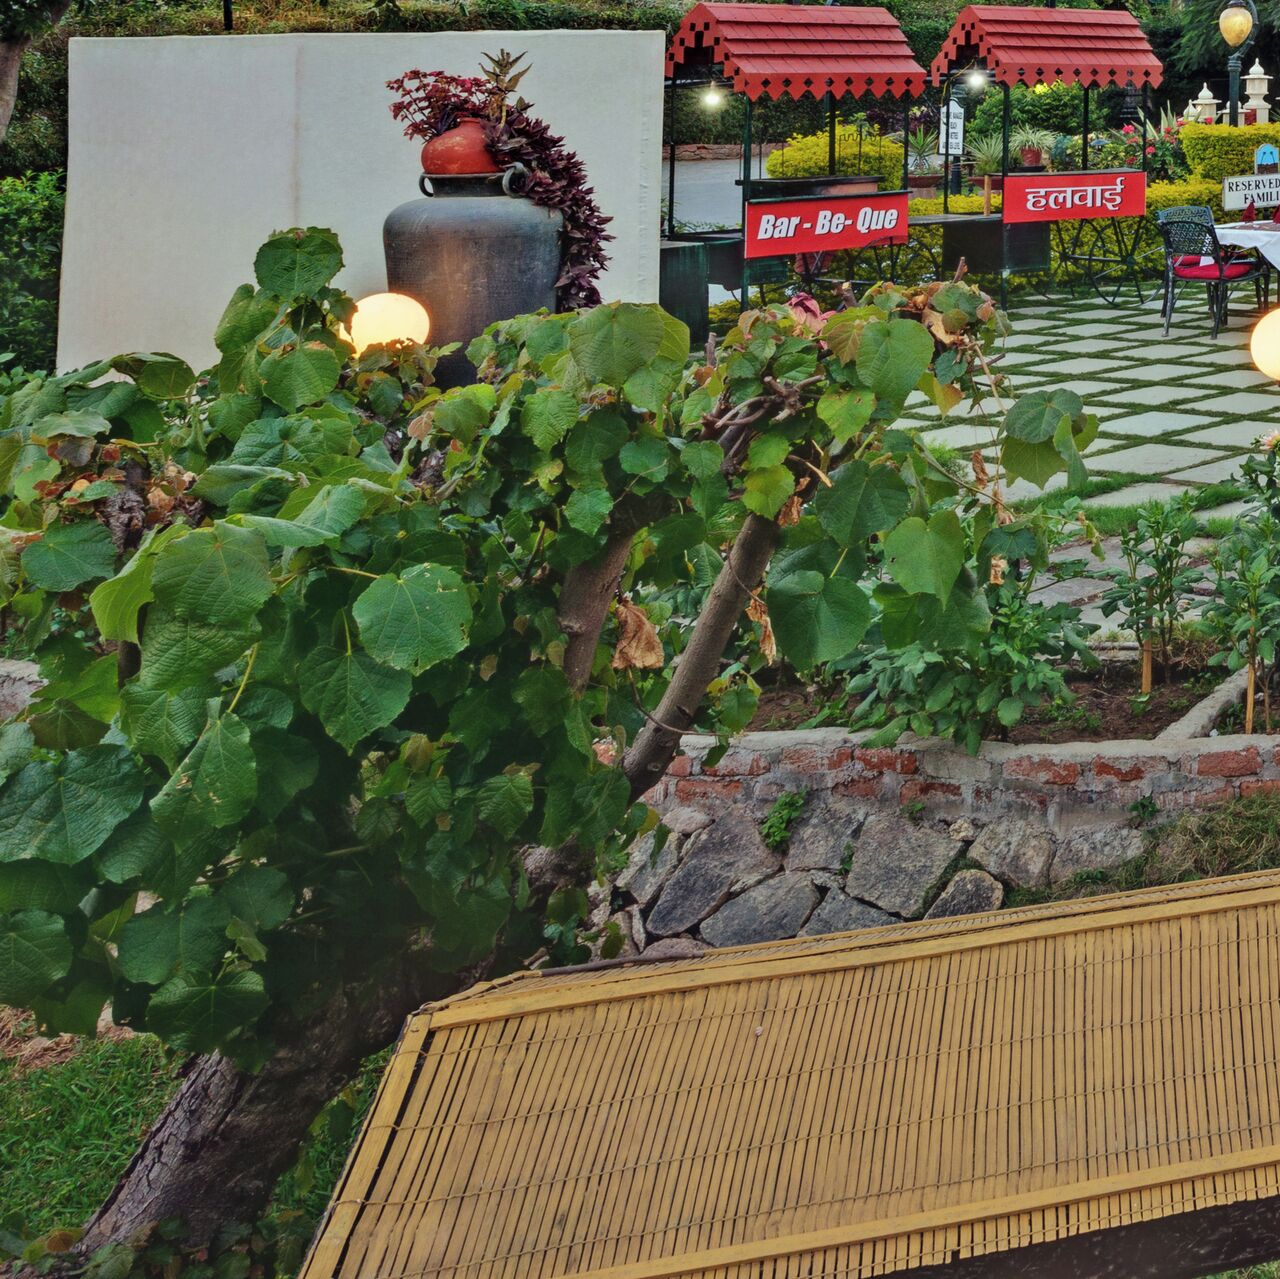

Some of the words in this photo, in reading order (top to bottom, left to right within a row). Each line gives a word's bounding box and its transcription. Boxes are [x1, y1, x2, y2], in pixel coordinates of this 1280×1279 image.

[1025, 177, 1125, 211] हलवाई
[1228, 178, 1280, 193] RESERVED
[757, 214, 801, 240] Bar
[856, 206, 899, 233] Que
